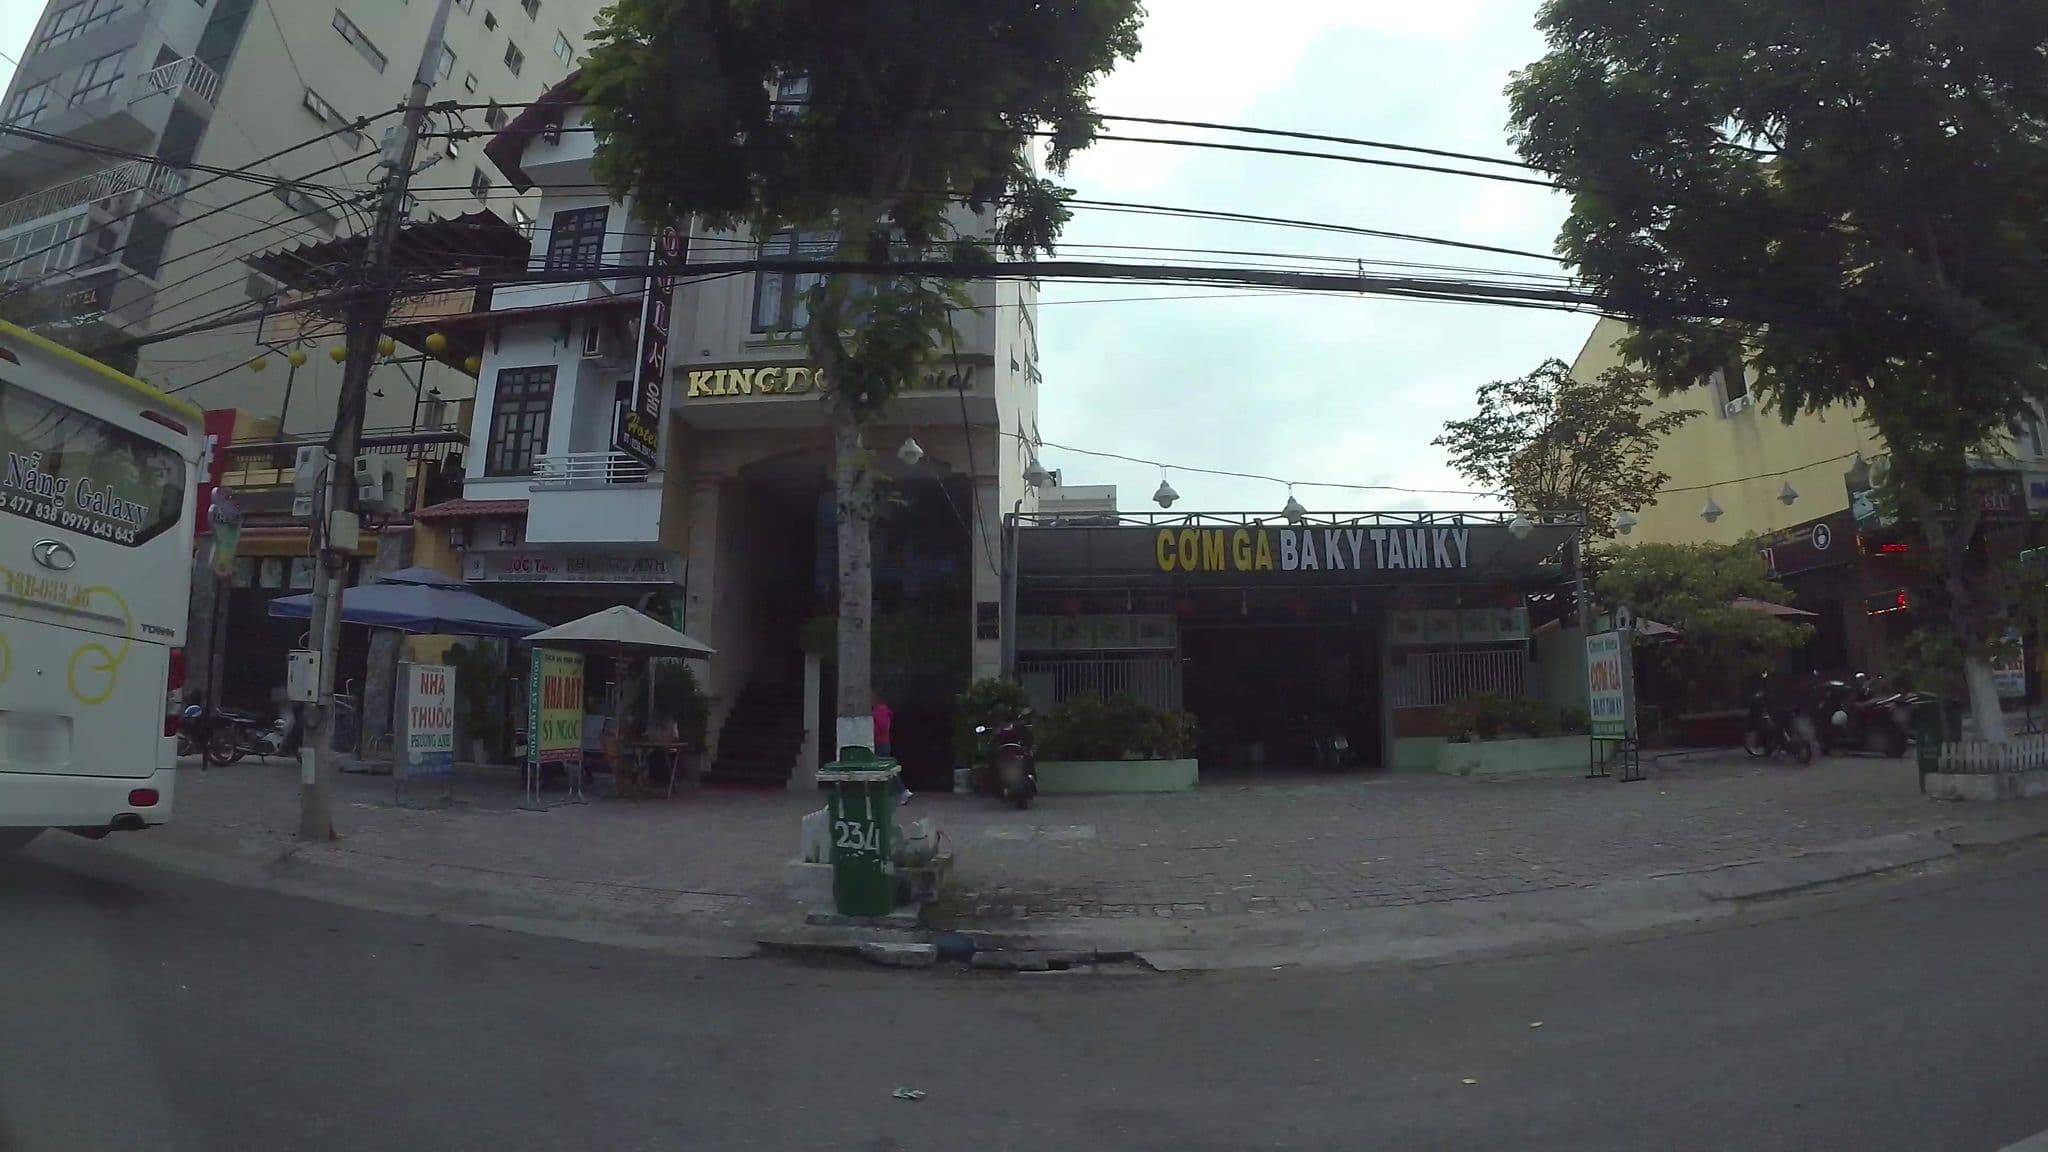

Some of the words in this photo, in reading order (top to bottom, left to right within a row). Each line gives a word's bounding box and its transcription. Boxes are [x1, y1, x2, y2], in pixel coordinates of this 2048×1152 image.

[3, 451, 69, 509] Nẵng
[75, 477, 150, 532] Galaxy
[9, 495, 33, 514] 477
[35, 502, 57, 521] 838
[61, 511, 90, 531] 0979
[92, 520, 113, 538] 643
[114, 526, 136, 543] 643
[1156, 528, 1225, 572] CƠM
[1231, 518, 1274, 572] GÀ
[1280, 517, 1320, 571] BÀ
[1324, 518, 1364, 570] KỲ
[1370, 528, 1429, 569] TAM
[1432, 518, 1470, 569] KỲ
[140, 623, 176, 638] TOWN
[420, 668, 446, 696] NHÀ
[411, 699, 452, 729] THUỐC
[834, 820, 881, 853] 234
